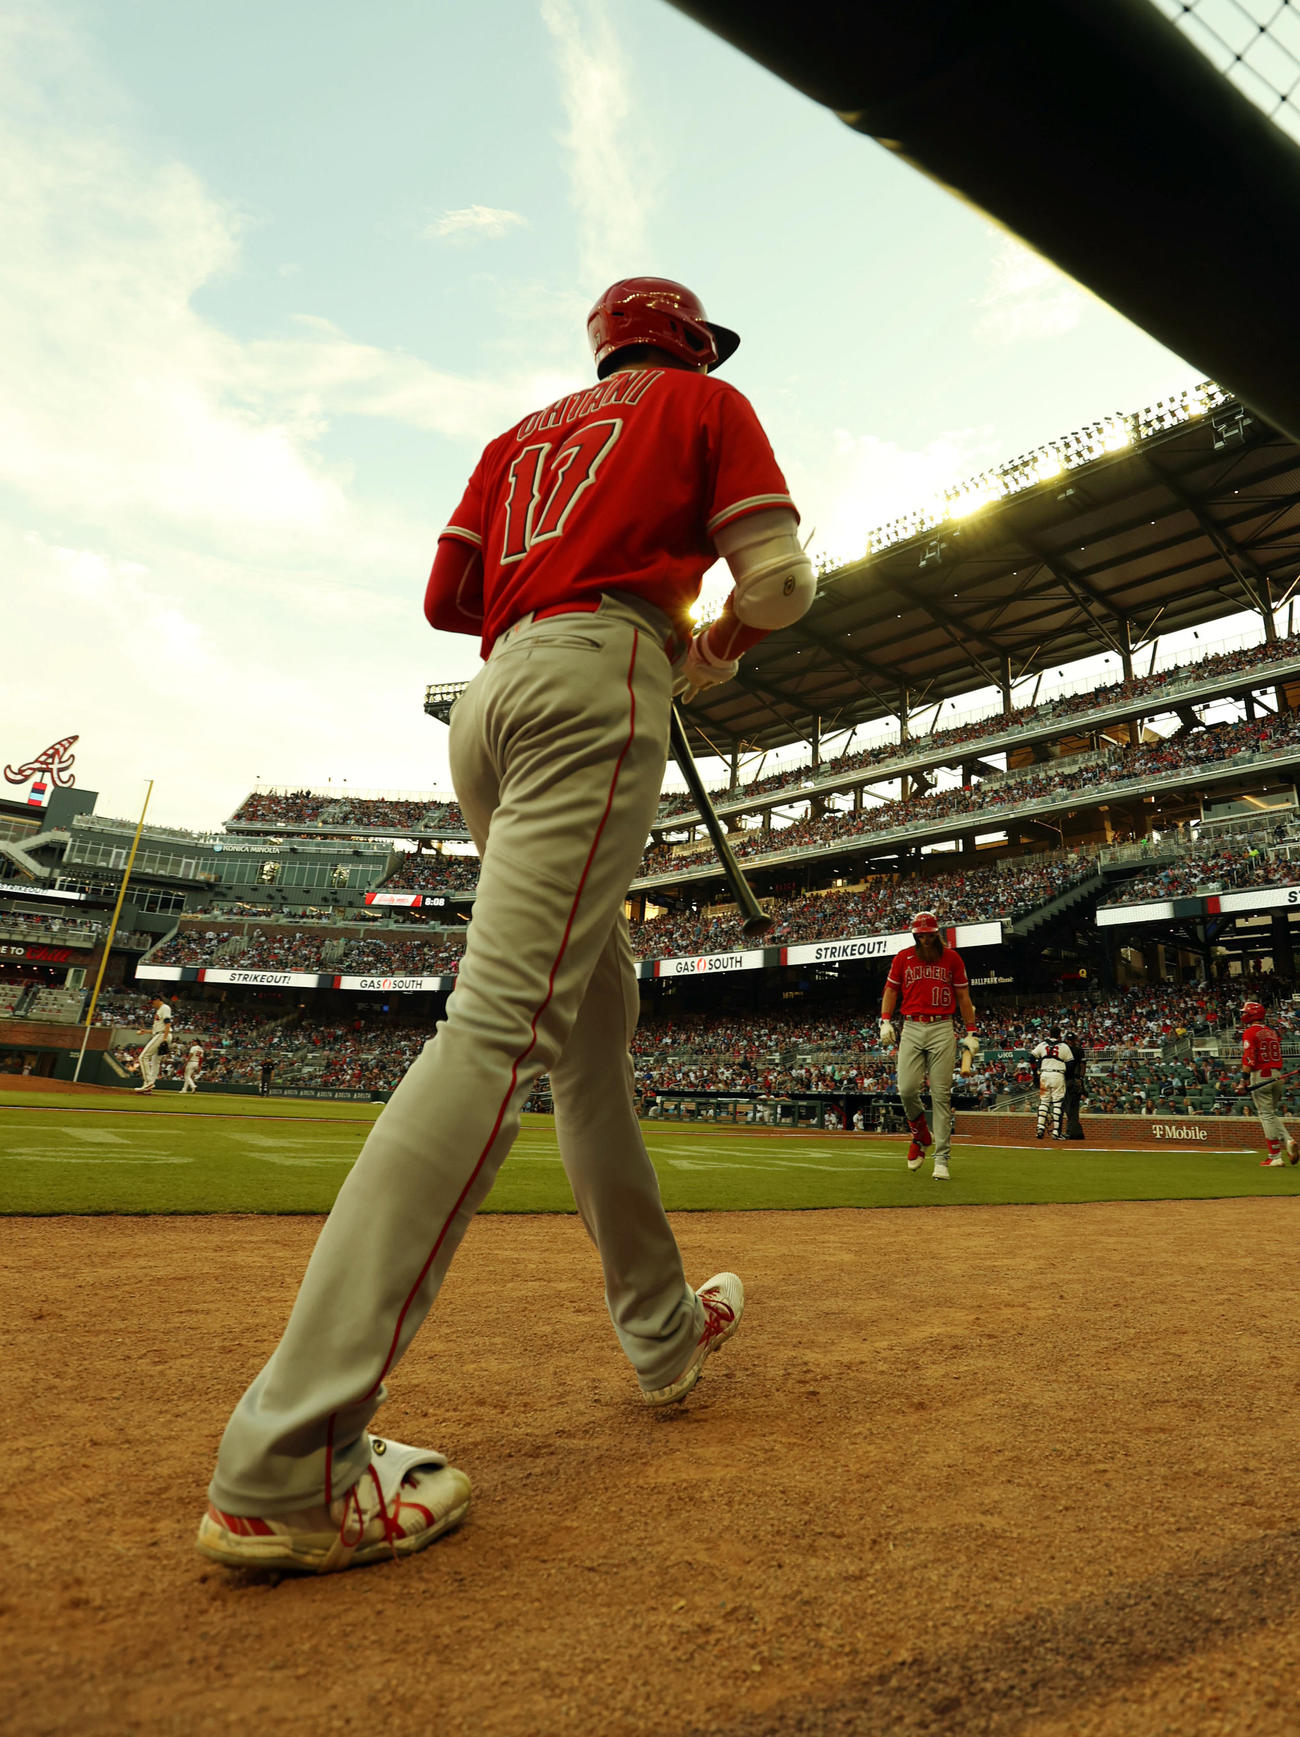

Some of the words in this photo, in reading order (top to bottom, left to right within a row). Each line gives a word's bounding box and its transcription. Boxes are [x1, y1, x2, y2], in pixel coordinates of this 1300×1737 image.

[500, 418, 624, 566] 17
[222, 845, 249, 853] KONICA
[250, 846, 280, 854] MINOLTA
[424, 897, 445, 906] 8:08
[1287, 890, 1300, 903] S
[10, 946, 24, 955] TO
[815, 940, 887, 960] STRIKEOUT!
[675, 960, 695, 973] GAS
[708, 956, 743, 971] SOUTH
[229, 972, 291, 984] STRIKEOUT!
[359, 978, 381, 989] GAS
[392, 979, 423, 990] SOUTH
[931, 986, 952, 1007] 16
[1260, 1040, 1280, 1061] 38
